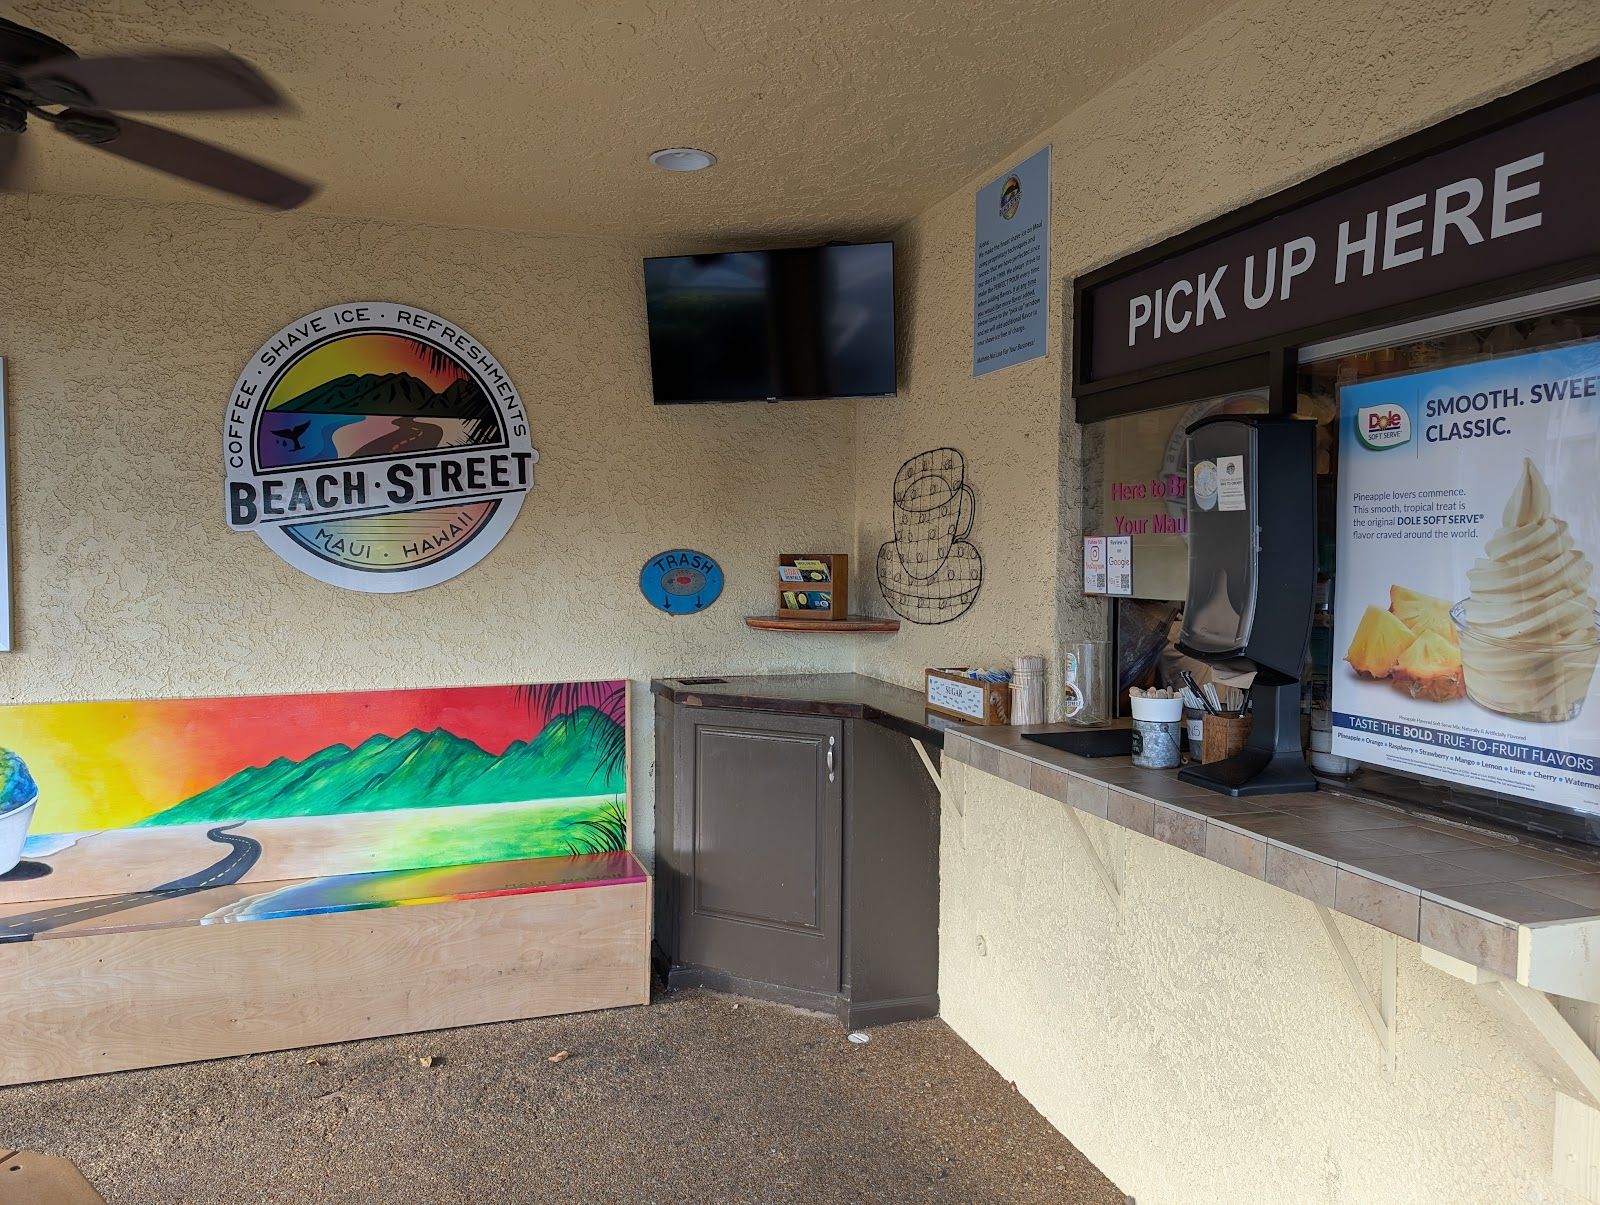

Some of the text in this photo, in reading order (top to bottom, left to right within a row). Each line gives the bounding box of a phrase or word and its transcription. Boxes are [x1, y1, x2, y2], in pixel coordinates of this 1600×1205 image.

[1128, 152, 1545, 346] PICK UP HERE
[228, 308, 526, 468] COFFEE SHAVE ICE REFRESHMENTS
[1426, 376, 1600, 418] SMOOTH. SWEE
[1369, 410, 1401, 428] Dole
[1426, 416, 1511, 442] CLASSIC.
[1368, 432, 1382, 440] SOFT
[230, 452, 532, 526] BEACH STREET
[1111, 476, 1187, 500] Here to Br
[1354, 488, 1466, 503] Pineapple lovers commence.
[1354, 501, 1466, 514] This smooth, tropical treat is
[1114, 514, 1188, 534] Your Mau
[1354, 518, 1366, 527] the
[1368, 516, 1396, 528] original
[1398, 516, 1421, 526] DOLE
[1424, 515, 1446, 525] SOFT
[315, 512, 473, 559] MAUI HAWAII
[1354, 528, 1478, 540] flavor craved around the world.
[653, 553, 714, 574] TRASH
[1109, 557, 1130, 568] Google
[946, 686, 962, 698] SUGAR
[1462, 726, 1480, 735] Naturally
[1349, 717, 1594, 771] TASTE THE BOLD, TRUE-TO-FRUIT FLAVORS
[1338, 732, 1360, 742] Pineapple
[1366, 738, 1383, 747] Orange
[1389, 742, 1414, 753] Raspberry
[1419, 749, 1449, 760] Strawberry
[1454, 756, 1475, 765] Mango
[1482, 761, 1502, 770] Lemon
[1510, 766, 1526, 775] Lime
[1533, 771, 1557, 782] Cherry
